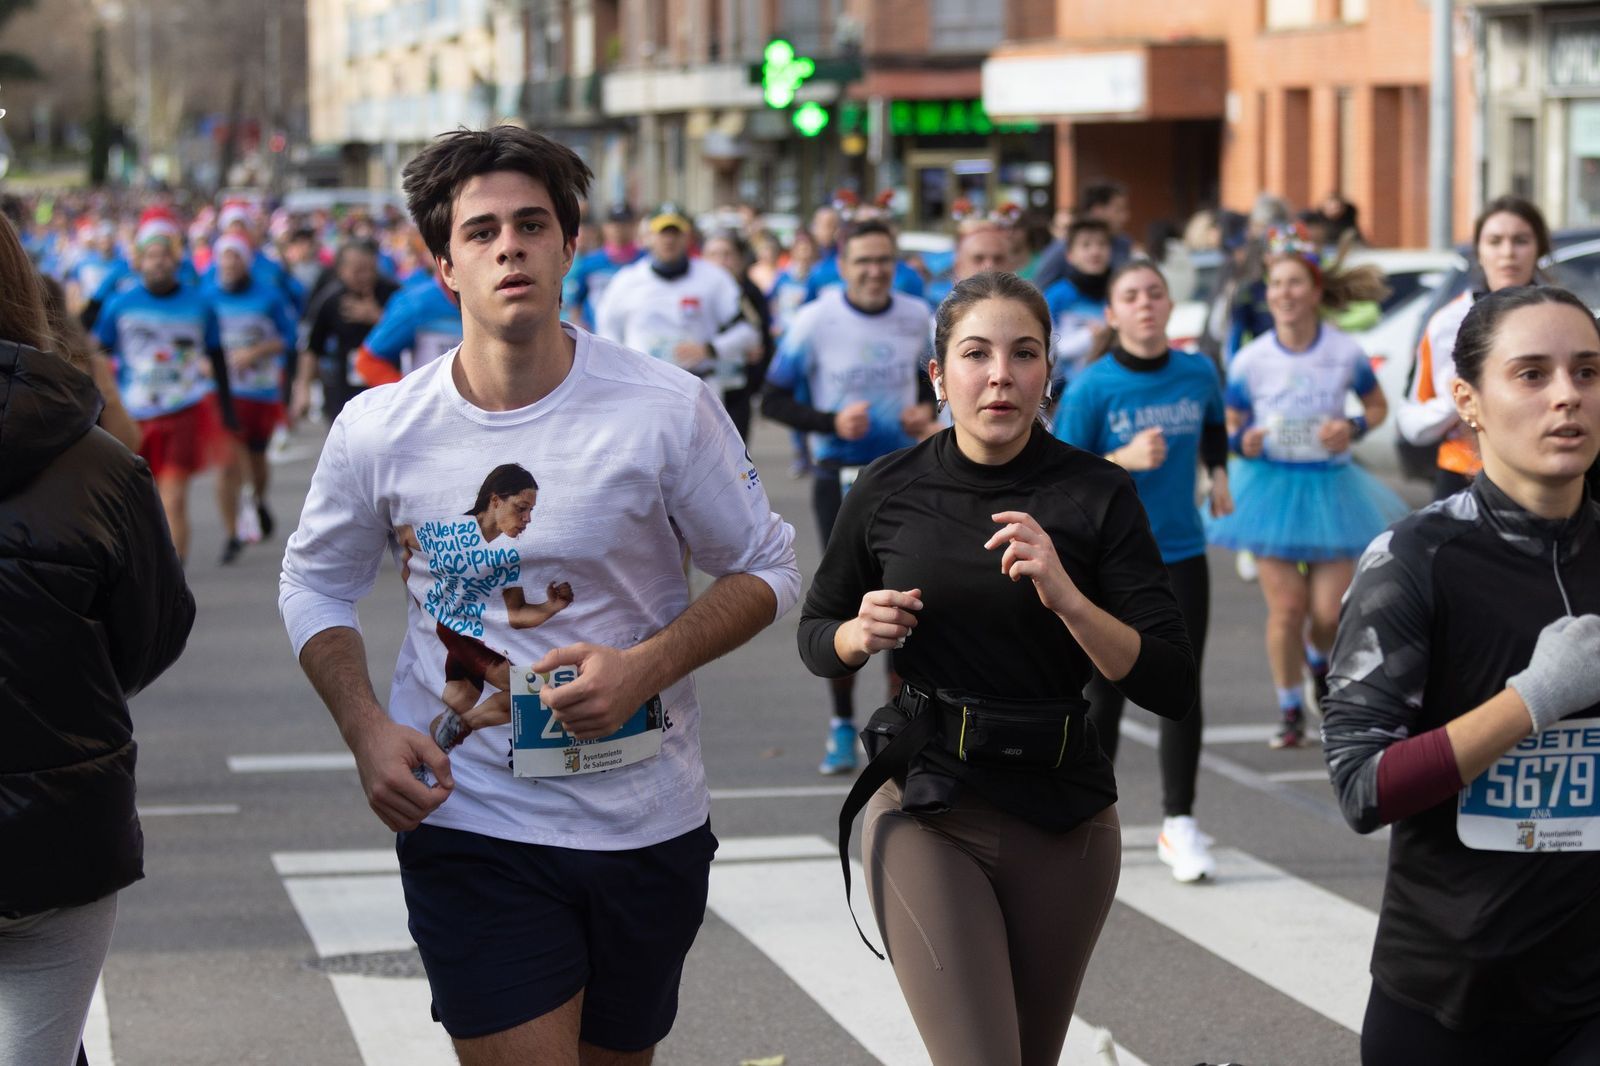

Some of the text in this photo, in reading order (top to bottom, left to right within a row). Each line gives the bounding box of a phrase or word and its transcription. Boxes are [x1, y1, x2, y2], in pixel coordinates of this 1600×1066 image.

[421, 534, 480, 558] impulso
[430, 548, 520, 574] disciplina
[583, 749, 622, 762] Ayuntamiento
[592, 758, 622, 769] Salamanca
[1485, 755, 1595, 808] 5679
[1529, 809, 1552, 819] ANA
[1538, 830, 1582, 839] Ayuntamiento
[1537, 840, 1582, 849] de Salamanca
